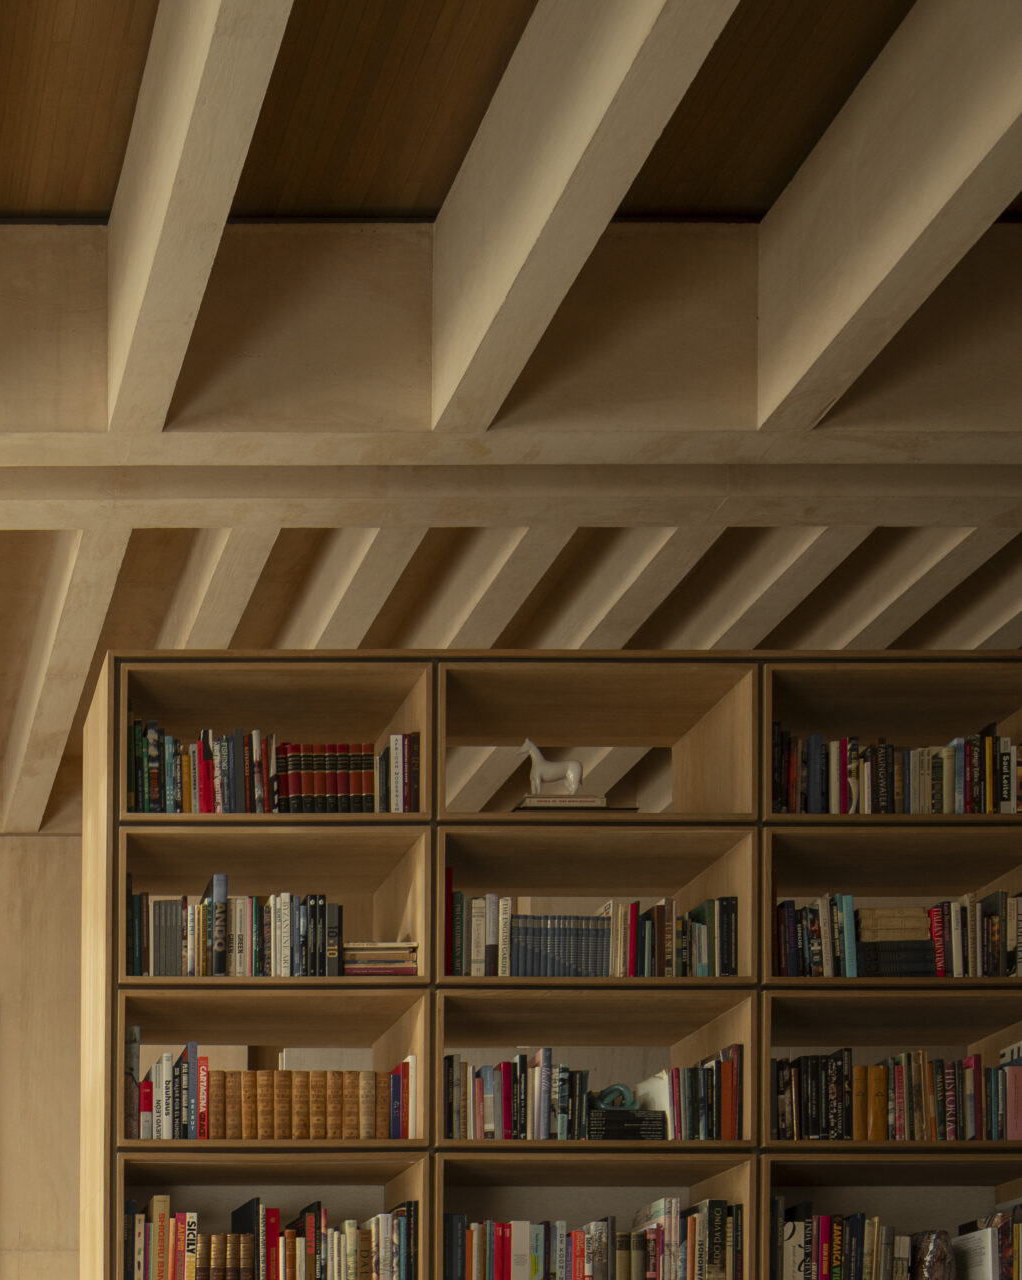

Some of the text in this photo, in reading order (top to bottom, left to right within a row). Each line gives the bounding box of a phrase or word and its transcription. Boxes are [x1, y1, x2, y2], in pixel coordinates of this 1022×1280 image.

[221, 742, 229, 770] FISHING
[1002, 756, 1010, 799] Saul Leiter
[215, 902, 227, 953] ANDO
[501, 917, 509, 946] ENGLISH
[665, 922, 673, 960] TURNER
[933, 908, 946, 971] ITALIAN PAINTING
[328, 945, 338, 958] 10
[500, 947, 508, 975] GARDEN
[198, 1066, 207, 1137] CARTAGENA GRACE
[936, 1074, 944, 1101] MAYAS
[945, 1069, 957, 1130] HISTORIA
[714, 1208, 722, 1231] VINCI
[177, 1222, 185, 1251] JAIPUR
[187, 1221, 196, 1255] SICILY
[307, 1216, 315, 1255] GIANTS
[559, 1233, 564, 1245] DE
[714, 1232, 722, 1243] DA
[833, 1223, 843, 1267] JAMAICA
